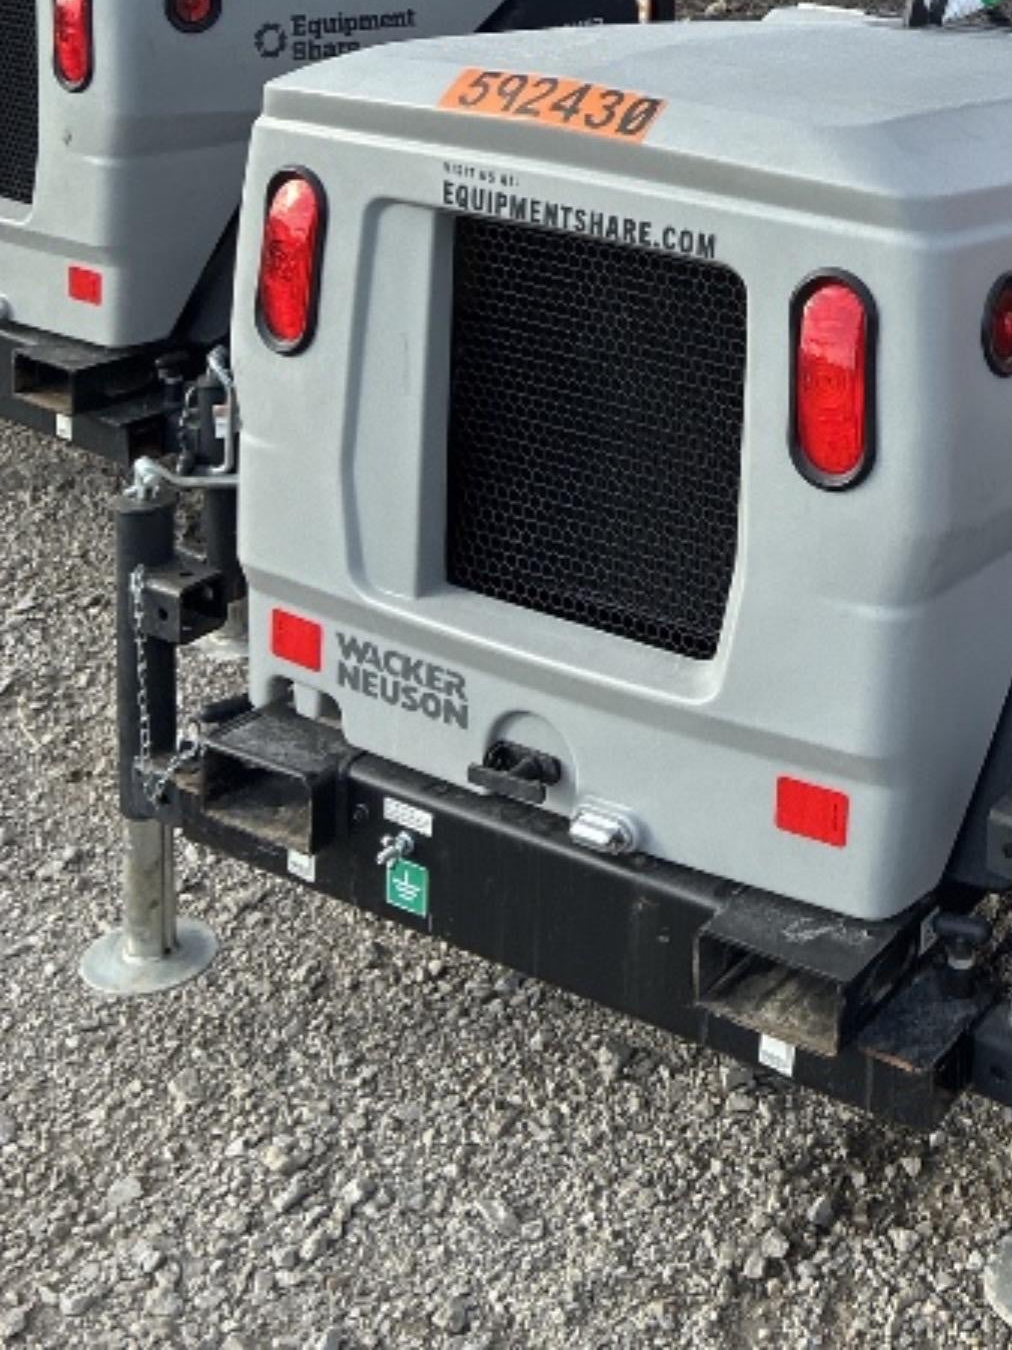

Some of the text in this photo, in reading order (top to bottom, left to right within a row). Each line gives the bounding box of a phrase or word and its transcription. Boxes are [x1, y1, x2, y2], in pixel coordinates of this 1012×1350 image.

[290, 8, 417, 39] Equipment
[458, 71, 662, 137] 592430
[443, 180, 717, 259] EQUIPMENTSHARE.COM
[336, 631, 468, 703] WACKER
[337, 659, 469, 730] NEUSON
